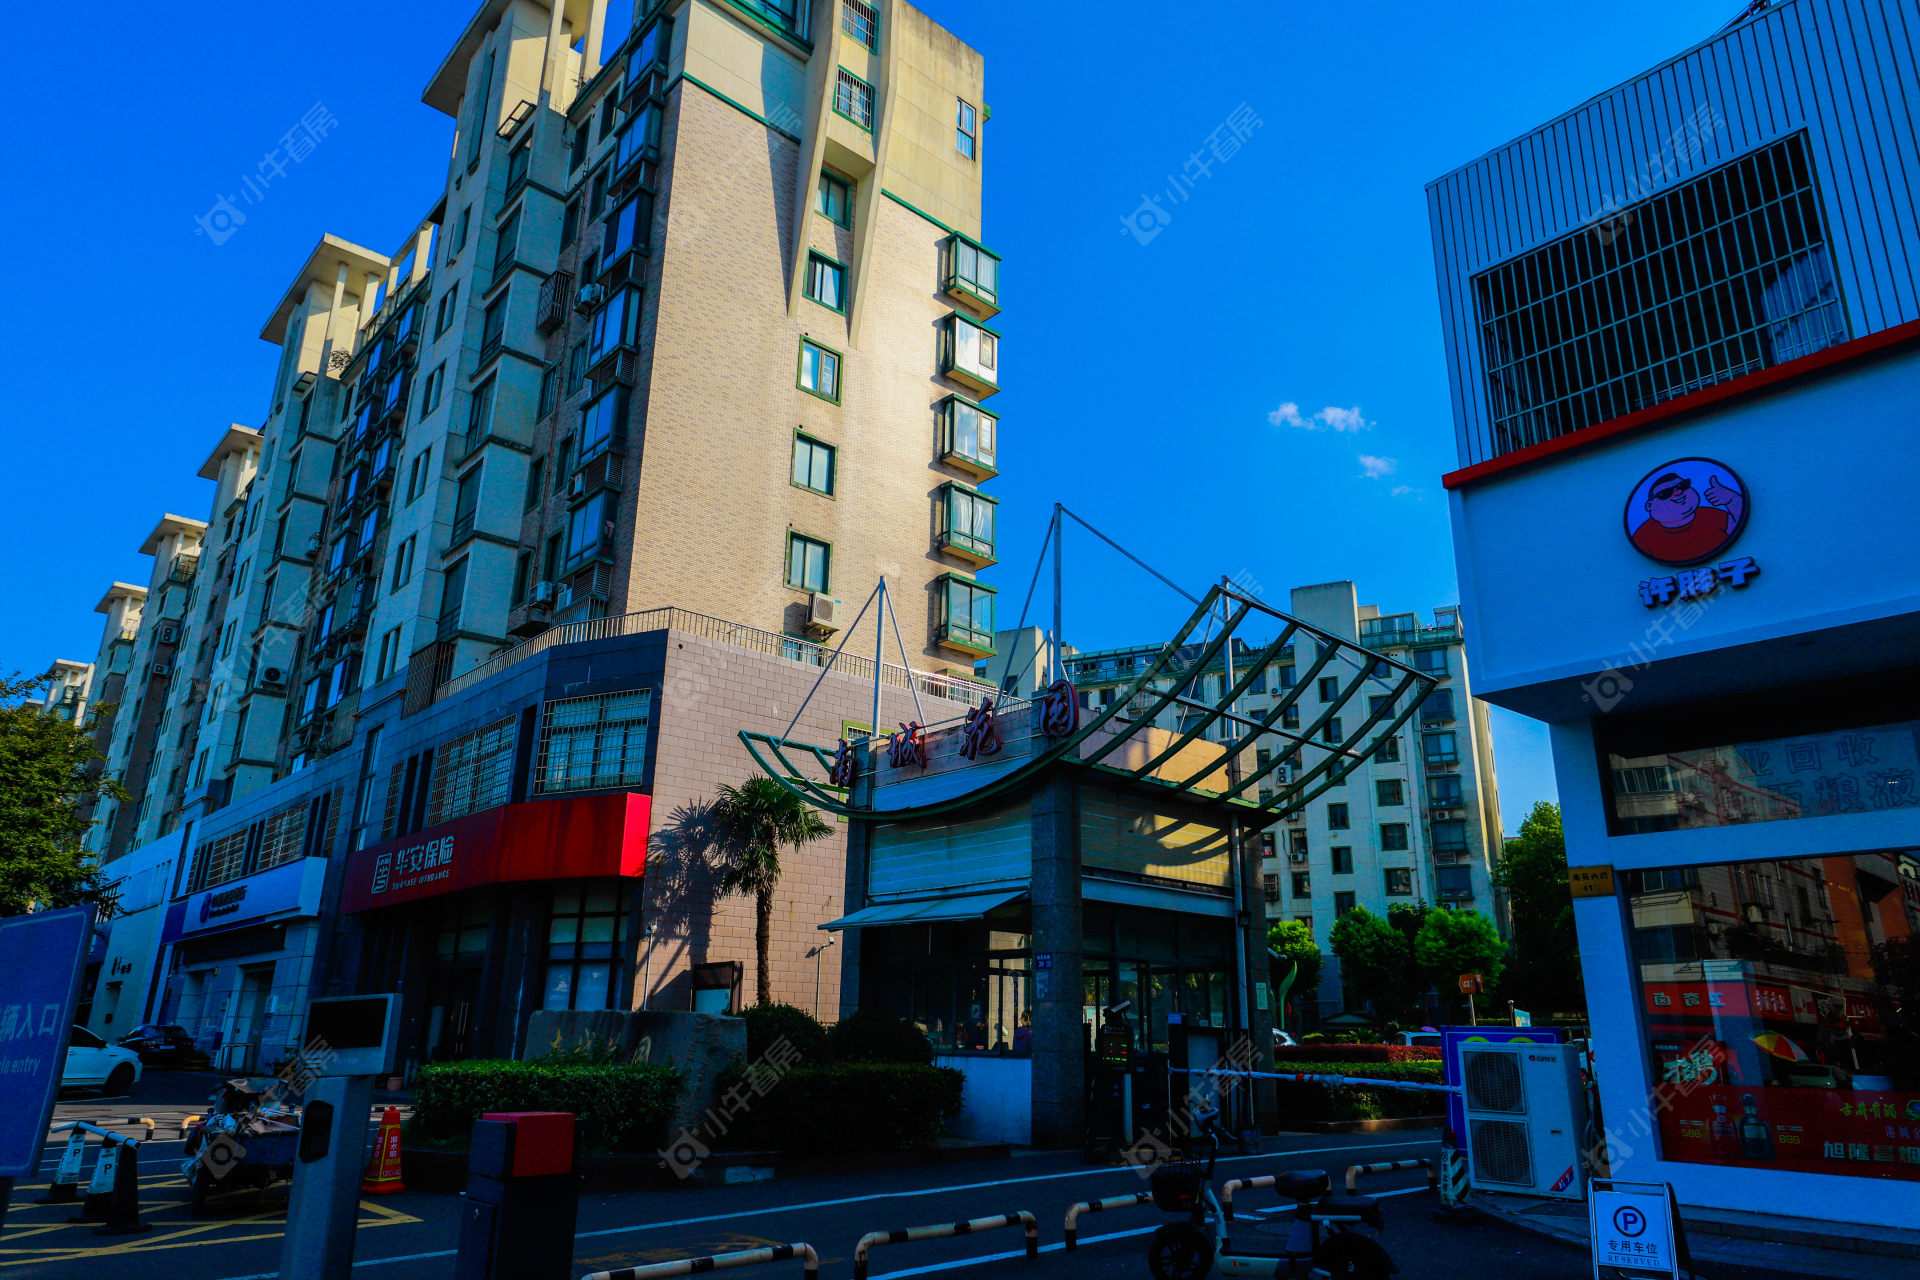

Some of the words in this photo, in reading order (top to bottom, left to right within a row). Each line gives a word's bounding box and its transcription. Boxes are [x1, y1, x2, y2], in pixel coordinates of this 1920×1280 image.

[1638, 556, 1760, 608] 许胖子
[395, 835, 455, 875] 华安保险
[418, 870, 450, 884] INSURANCE
[0, 1003, 60, 1042] 辆入口
[11, 1056, 41, 1077] entry
[1663, 1049, 1718, 1086] 招聘
[73, 1148, 80, 1157] P
[104, 1163, 112, 1174] P
[1622, 1212, 1638, 1231] P
[1608, 1239, 1657, 1254] 专用车位
[1608, 1255, 1660, 1266] RESERVED
